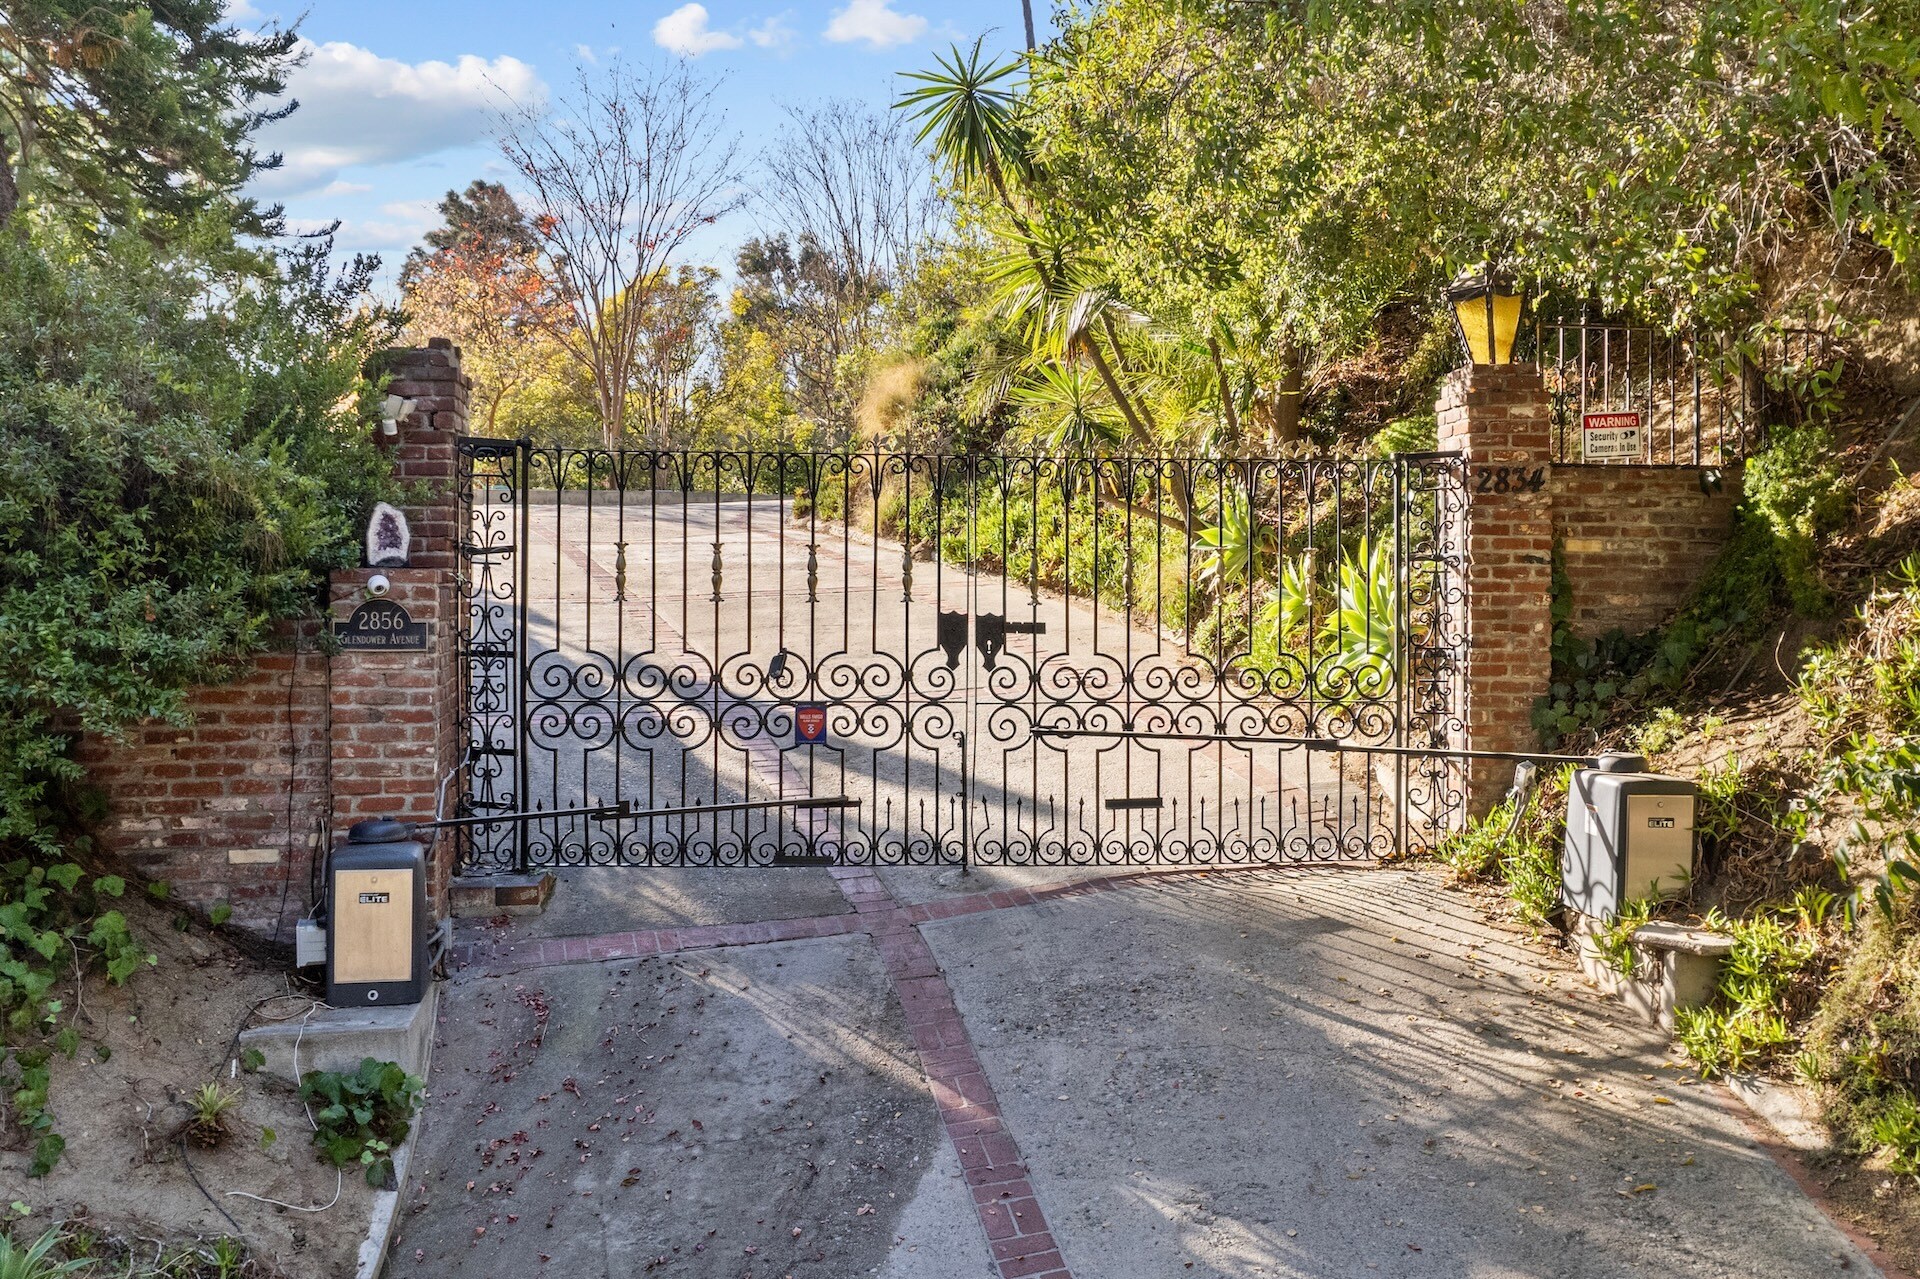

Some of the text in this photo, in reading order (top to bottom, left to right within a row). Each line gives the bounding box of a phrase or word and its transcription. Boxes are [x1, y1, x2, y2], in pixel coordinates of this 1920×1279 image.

[1588, 415, 1637, 428] WARNING
[1589, 431, 1618, 442] Security
[1590, 443, 1618, 453] Cameras
[1627, 442, 1637, 452] Use
[1476, 466, 1546, 494] 2834
[359, 611, 404, 630] 2856
[390, 633, 420, 645] AVENUE
[1648, 820, 1674, 828] ELITE
[359, 895, 389, 903] ELITE
